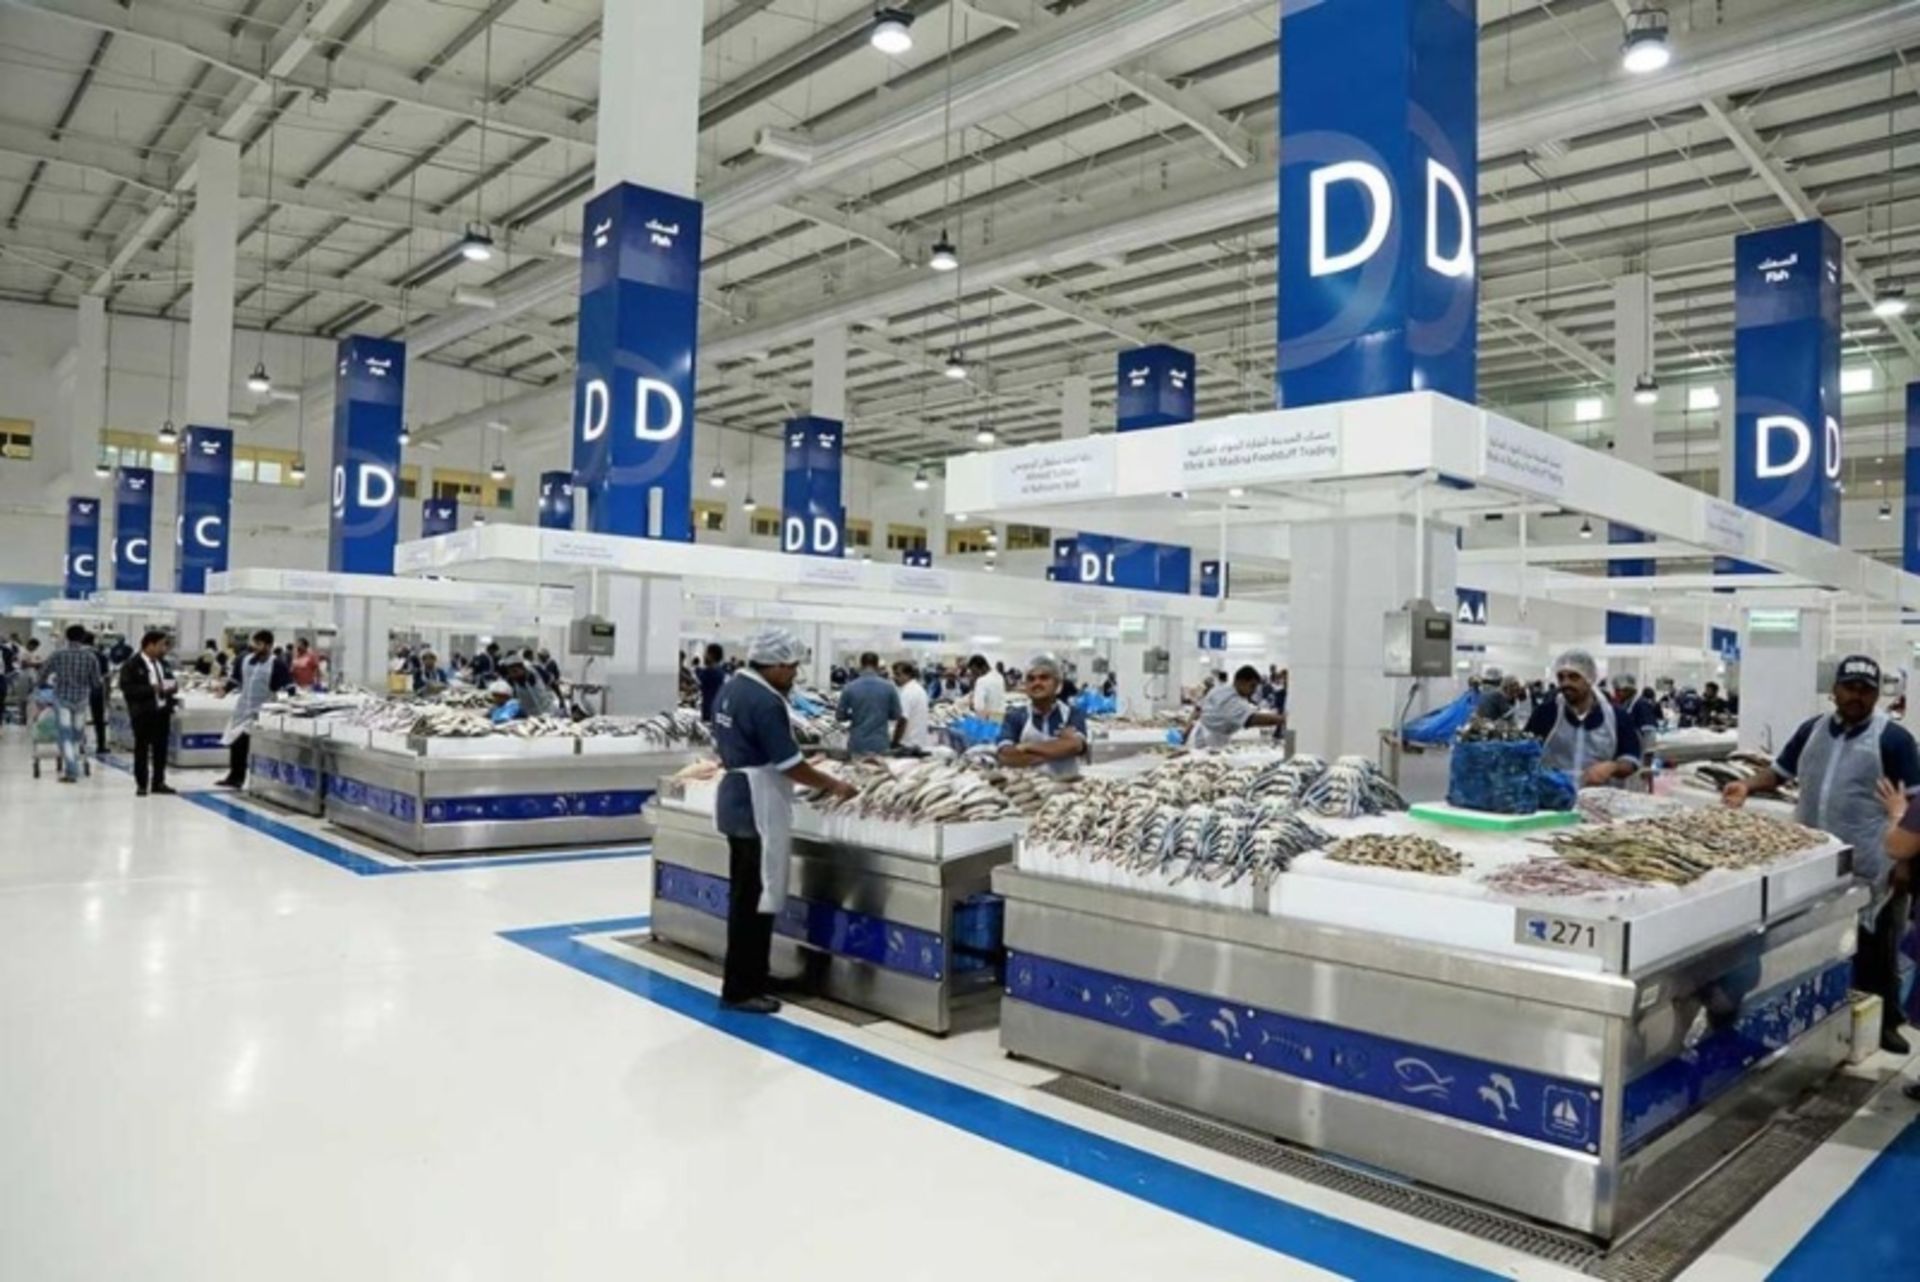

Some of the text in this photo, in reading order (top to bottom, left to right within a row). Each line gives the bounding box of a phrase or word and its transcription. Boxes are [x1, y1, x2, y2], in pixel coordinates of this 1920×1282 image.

[1310, 160, 1392, 278] D
[1427, 157, 1474, 277] D
[583, 379, 610, 442] D
[635, 377, 683, 440] D
[1300, 444, 1337, 459] Trading
[1757, 415, 1811, 478] D
[358, 463, 395, 507] D
[195, 516, 221, 548] C
[786, 517, 805, 551] D
[813, 517, 838, 552] D
[73, 554, 94, 577] C
[125, 538, 148, 564] C
[1081, 553, 1100, 582] D
[1458, 602, 1474, 622] A
[1551, 919, 1595, 948] 271
